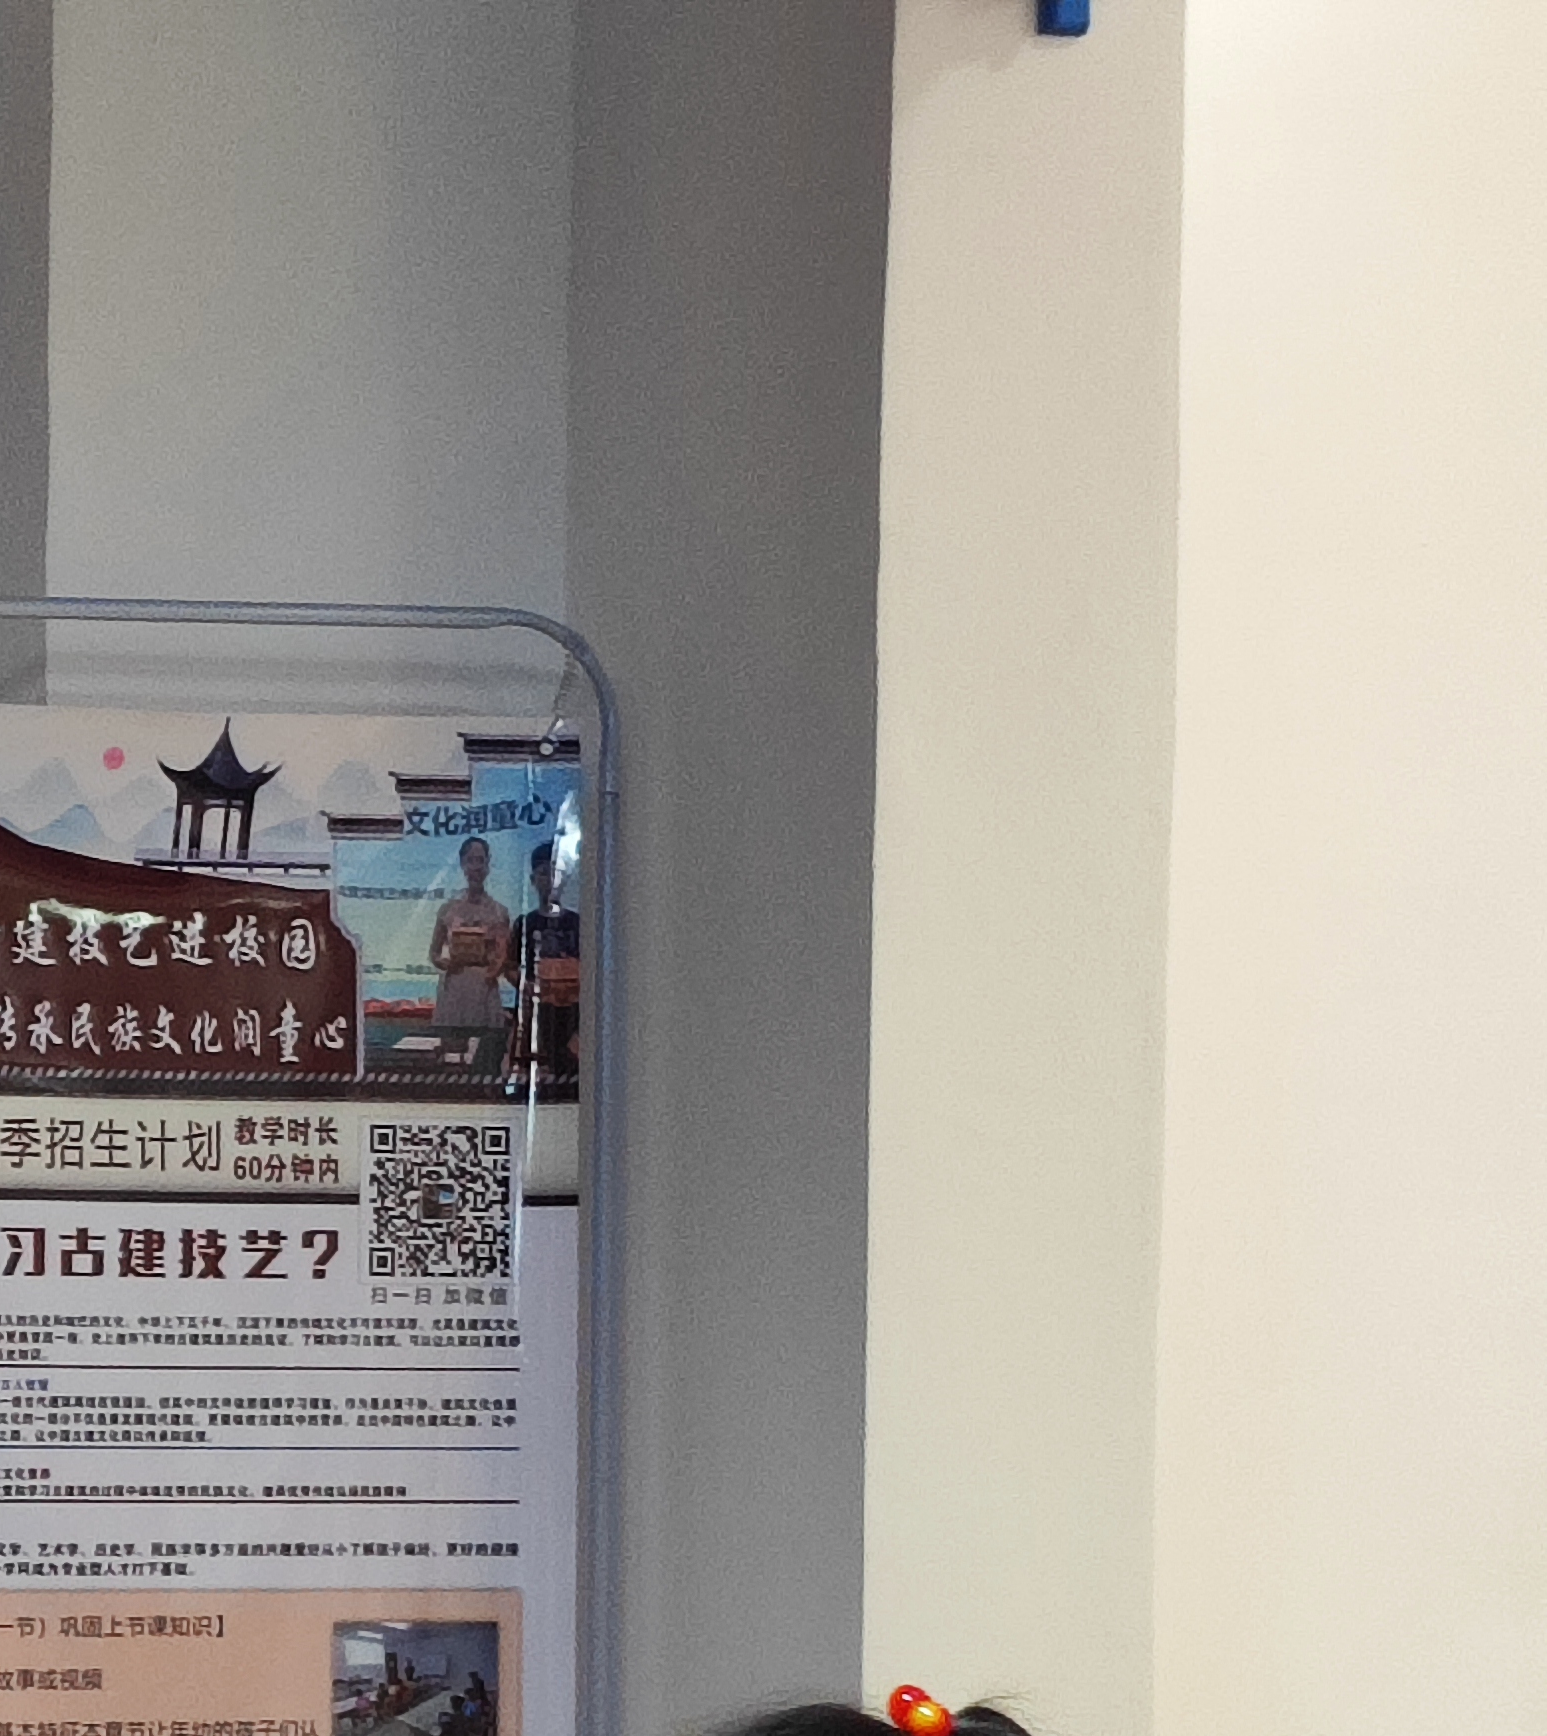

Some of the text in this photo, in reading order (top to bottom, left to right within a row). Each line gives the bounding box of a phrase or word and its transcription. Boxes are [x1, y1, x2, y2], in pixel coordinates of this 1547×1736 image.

[234, 1116, 339, 1147] 教学时长
[233, 1154, 339, 1184] 60分钟内
[371, 1287, 431, 1305] 扫一扫
